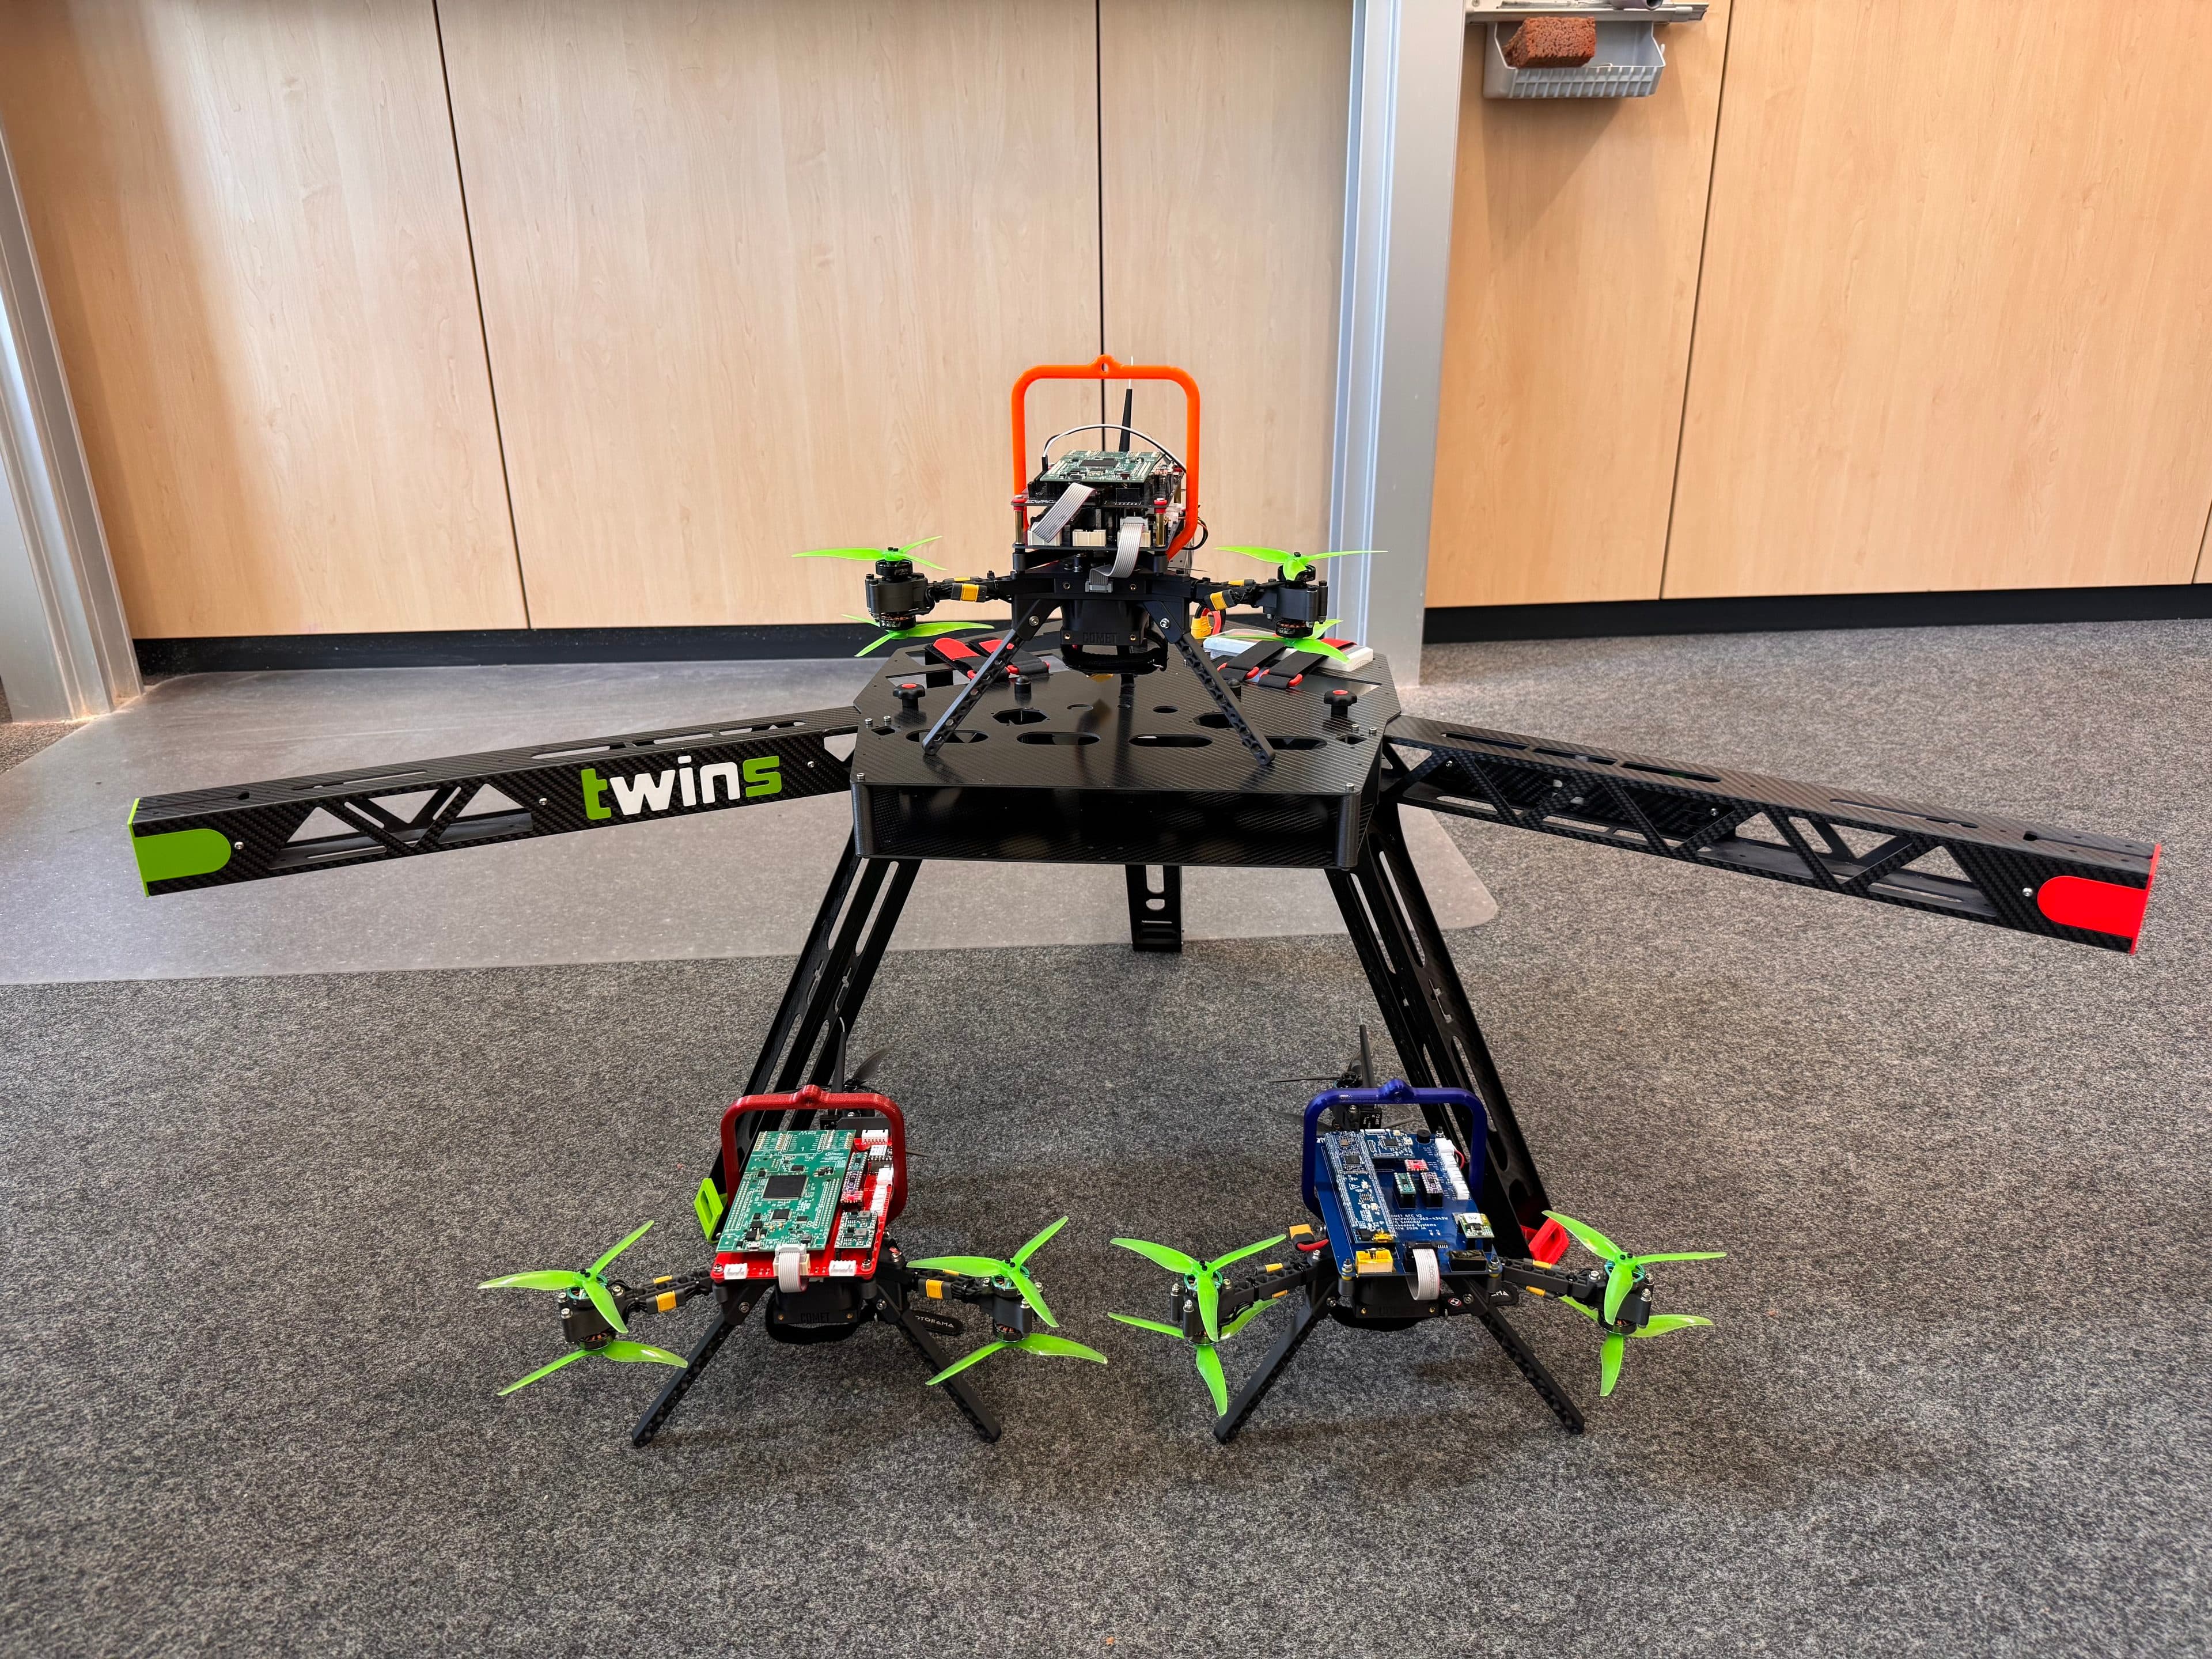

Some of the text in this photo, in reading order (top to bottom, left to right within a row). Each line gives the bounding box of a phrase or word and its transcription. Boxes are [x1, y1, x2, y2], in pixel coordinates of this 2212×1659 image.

[1083, 632, 1117, 644] COMET
[581, 755, 782, 820] twins
[915, 1315, 954, 1328] OTORAMA
